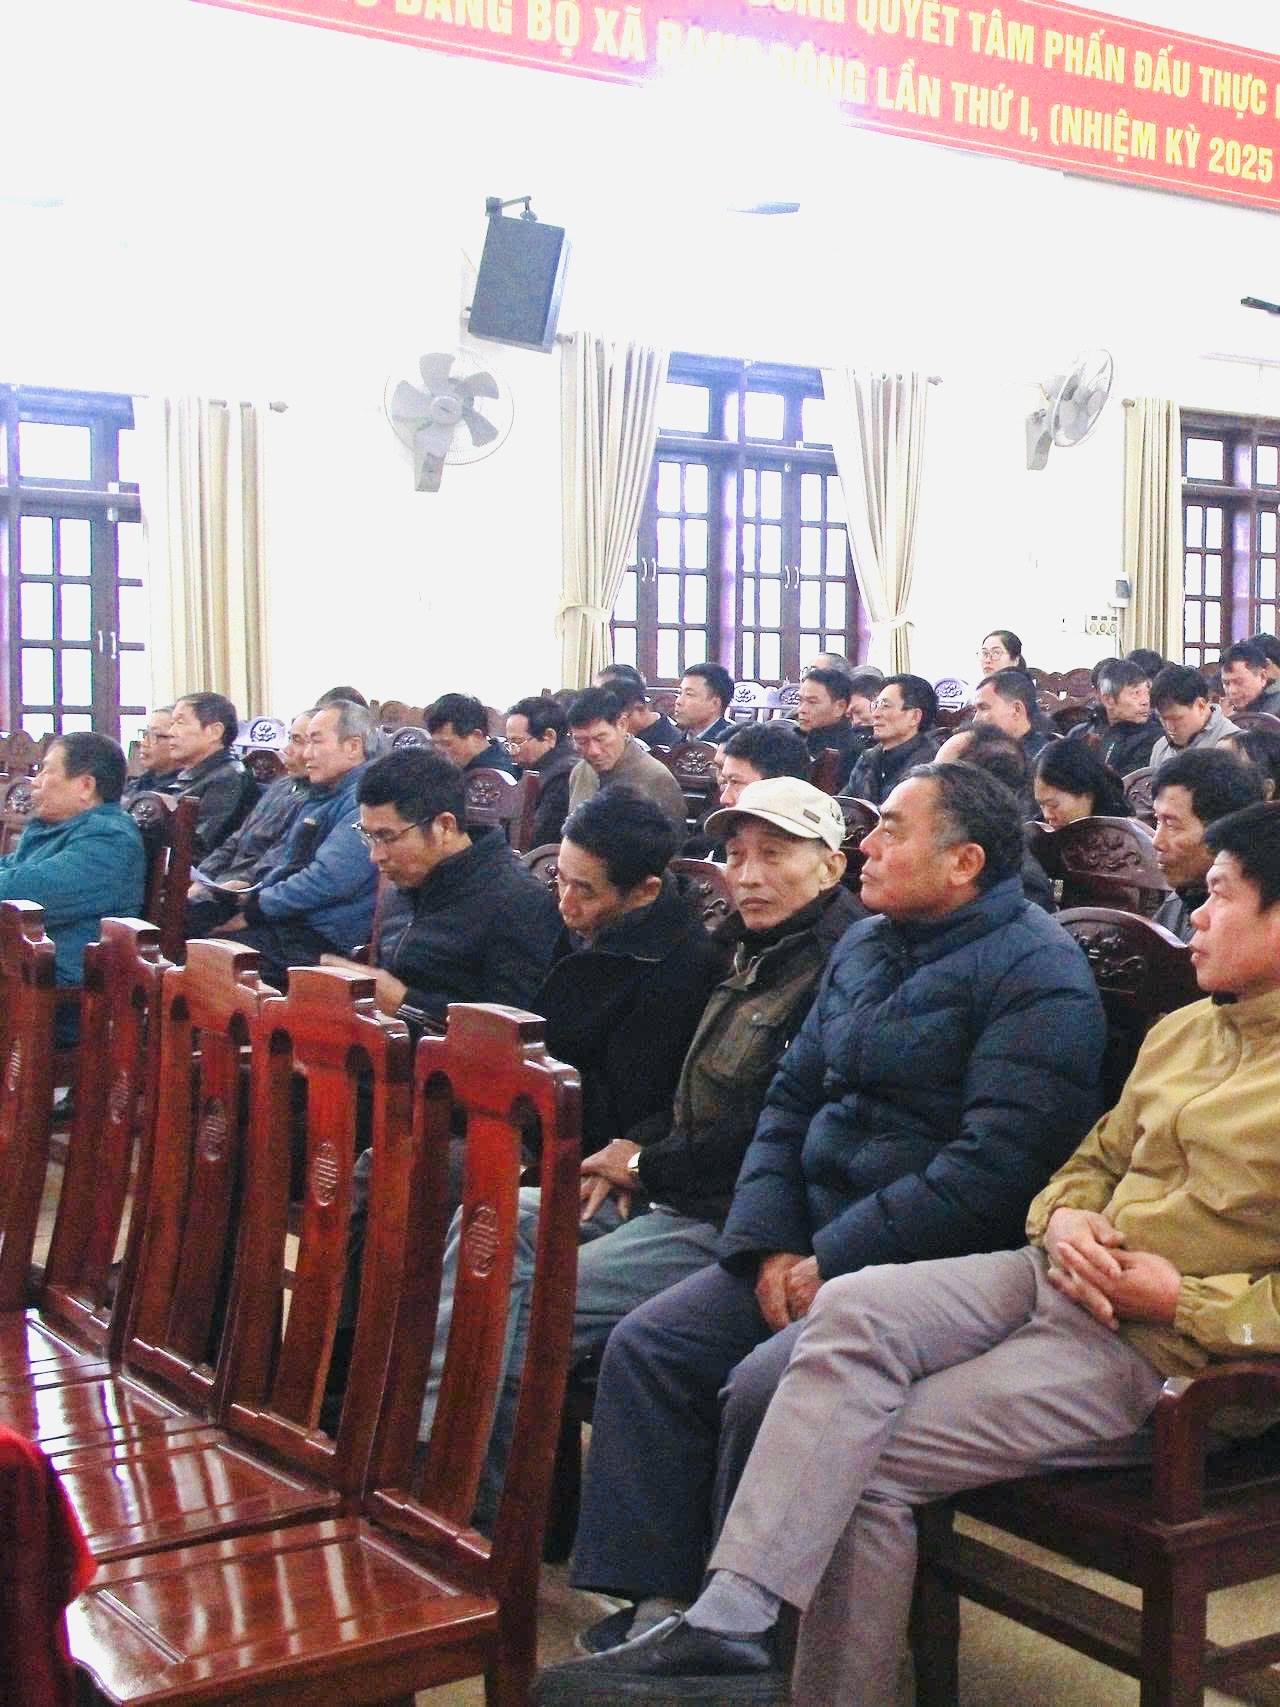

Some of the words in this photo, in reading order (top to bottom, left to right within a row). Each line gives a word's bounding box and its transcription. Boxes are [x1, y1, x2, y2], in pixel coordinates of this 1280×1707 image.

[591, 6, 646, 61] XÃ
[876, 57, 942, 118] LẦN
[951, 81, 1014, 130] THỨ
[1019, 96, 1039, 142] I,
[1049, 103, 1157, 163] (NHIỆM
[1165, 123, 1201, 169] KỲ
[1207, 137, 1274, 184] 2025
[968, 8, 1035, 65] TÂM
[1043, 28, 1126, 84] PHẤN
[1133, 44, 1191, 98] ĐẤU
[1199, 65, 1268, 119] THỰC
